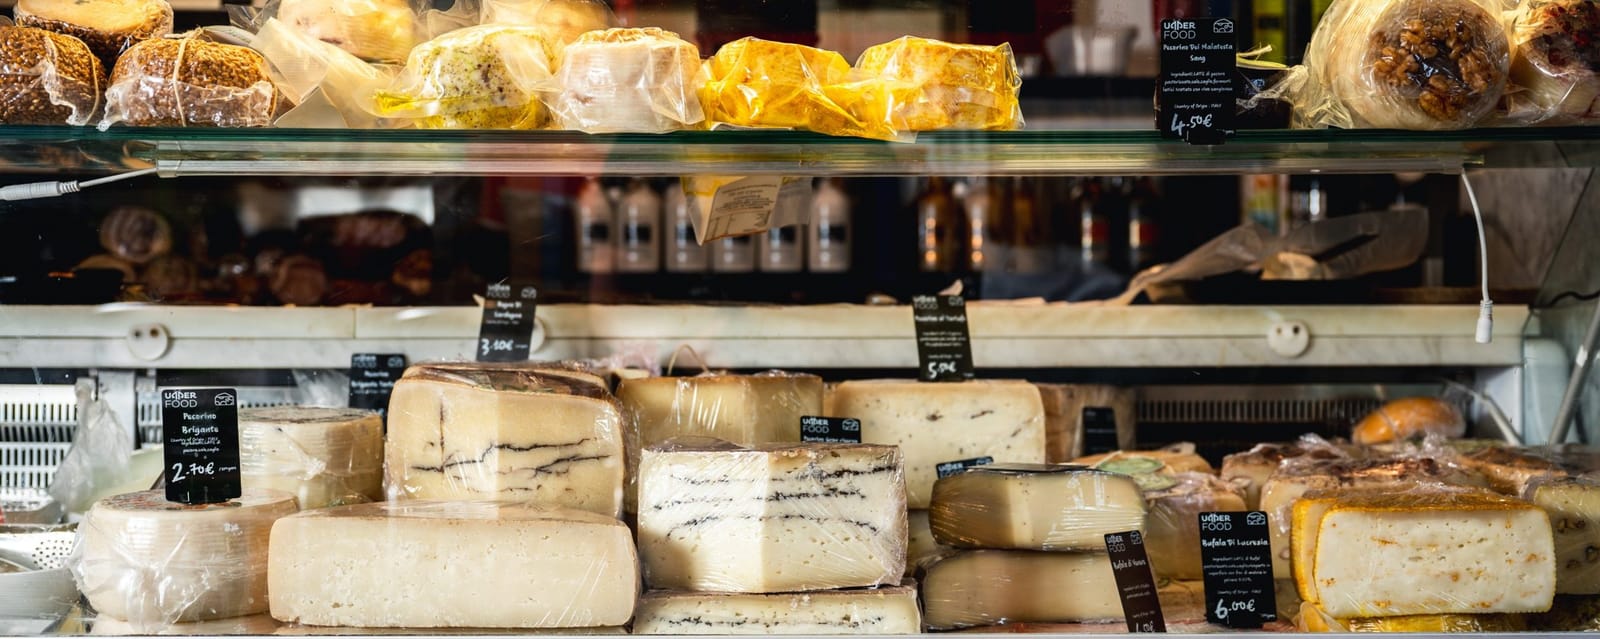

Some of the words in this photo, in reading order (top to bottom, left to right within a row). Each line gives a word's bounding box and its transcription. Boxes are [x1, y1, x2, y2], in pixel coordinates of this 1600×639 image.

[1163, 20, 1196, 31] UDDER
[1164, 31, 1196, 39] FOOD
[165, 391, 197, 400] UDDER
[165, 400, 198, 408] FOOD
[183, 412, 217, 420] Pecorino
[181, 425, 219, 436] Brigante
[803, 425, 829, 433] FOOD
[172, 462, 215, 483] 2.70€
[1201, 514, 1231, 523] UDDER
[1202, 522, 1232, 531] FOOD
[1202, 537, 1227, 548] Bufala
[1108, 543, 1126, 553] FOOD
[1214, 598, 1255, 619] 6.00€
